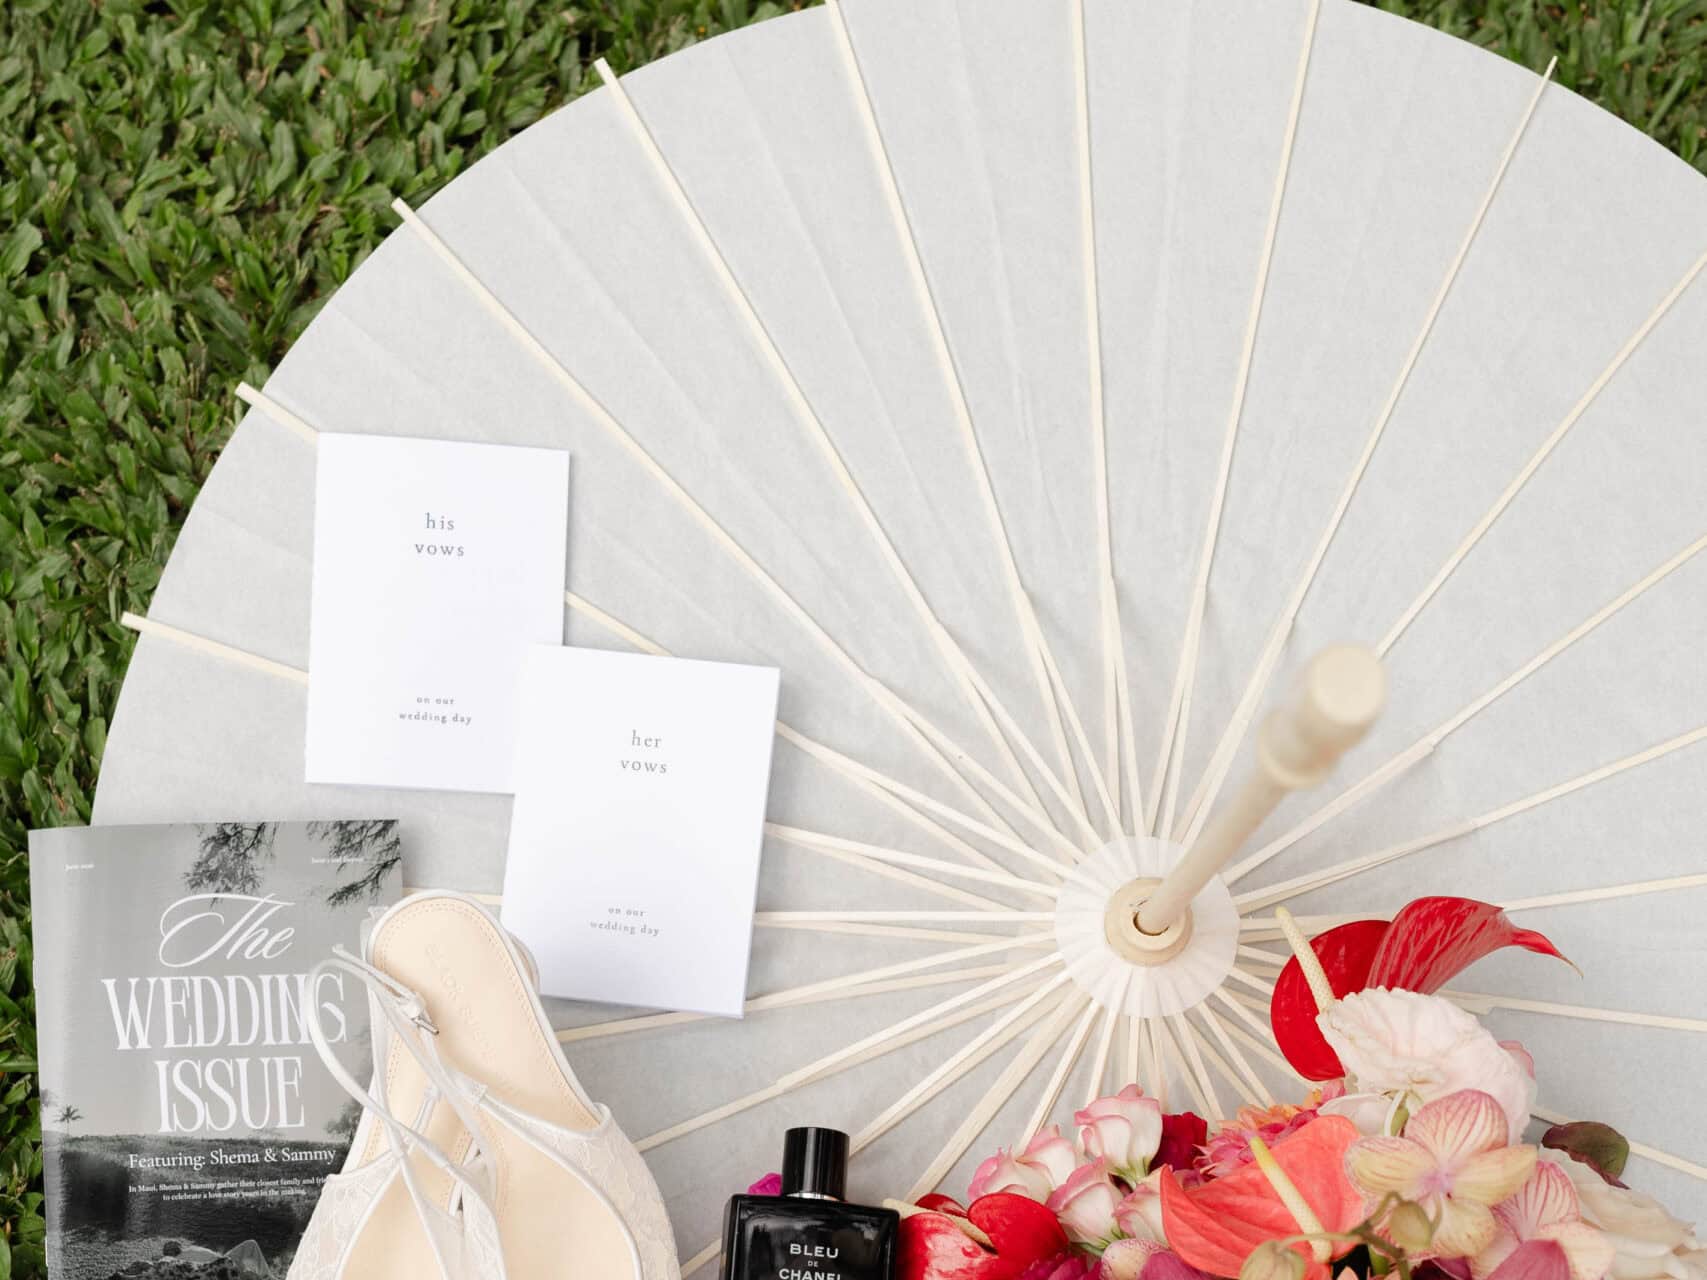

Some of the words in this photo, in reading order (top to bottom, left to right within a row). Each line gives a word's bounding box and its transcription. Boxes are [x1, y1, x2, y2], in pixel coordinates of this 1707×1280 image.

[425, 512, 455, 530] his
[414, 544, 465, 557] vows
[399, 712, 447, 724] wedding
[452, 713, 472, 726] day
[632, 729, 661, 748] her
[620, 760, 667, 774] vows
[626, 909, 645, 917] our
[159, 892, 296, 968] The
[590, 920, 636, 935] wedding
[640, 924, 659, 937] day
[101, 972, 348, 1051] WEDDING
[155, 1056, 306, 1134] ISSUE
[128, 1153, 206, 1170] Featuring:
[210, 1149, 260, 1165] Shema
[264, 1148, 277, 1162] &
[281, 1147, 336, 1165] Sammy
[789, 1243, 839, 1259] BLEU
[807, 1260, 819, 1268] DE
